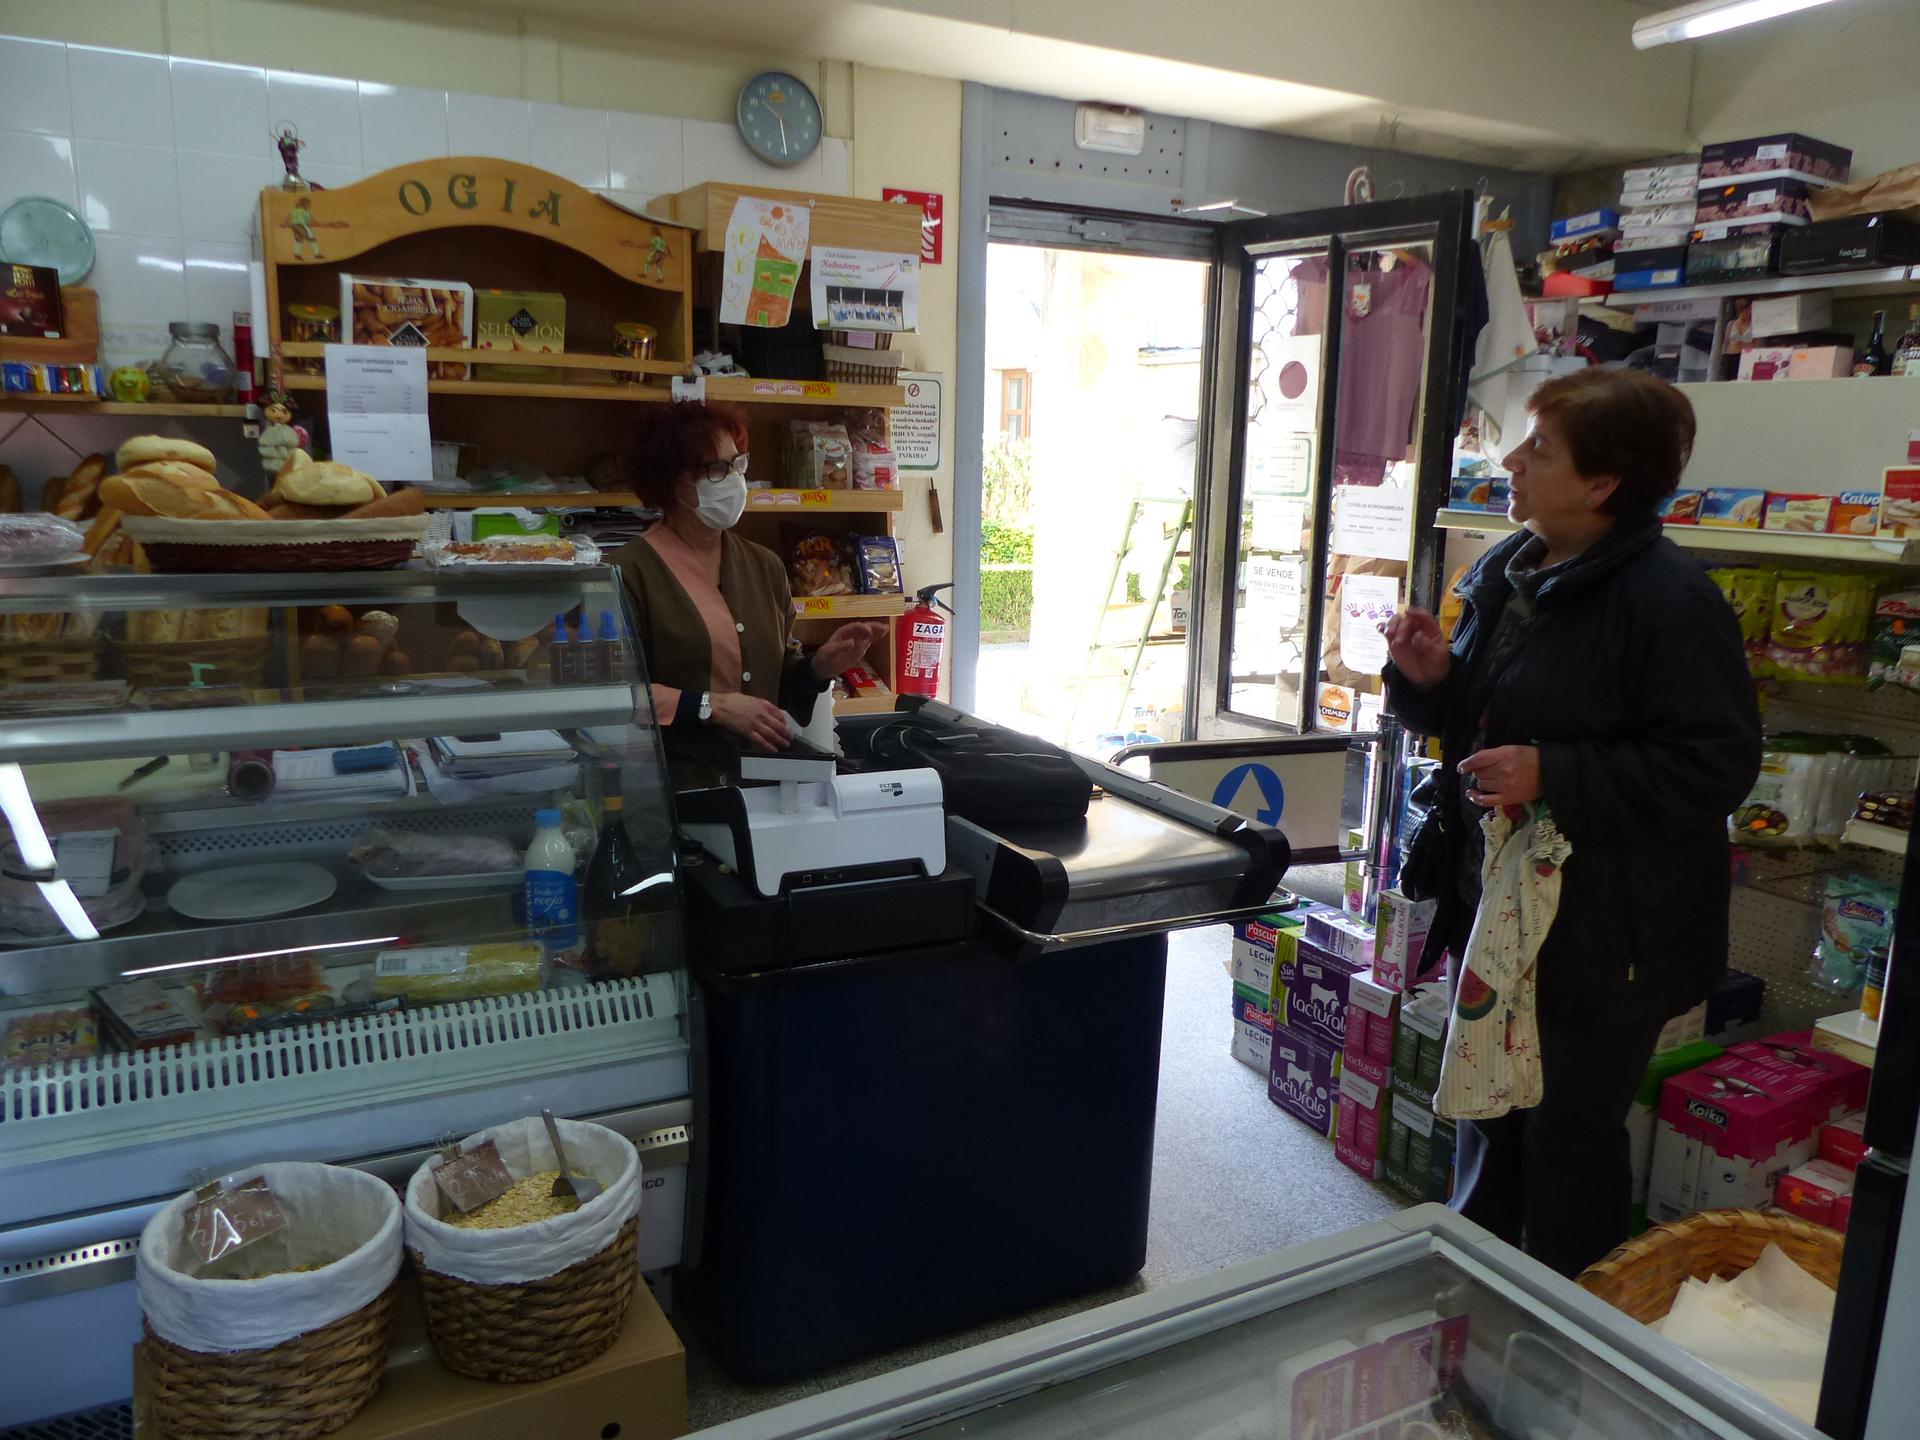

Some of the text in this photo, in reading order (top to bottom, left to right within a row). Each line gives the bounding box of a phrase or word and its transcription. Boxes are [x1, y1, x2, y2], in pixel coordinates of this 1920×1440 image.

[398, 173, 564, 227] OGIA
[478, 319, 566, 338] SELEIÓN
[1840, 493, 1881, 506] Calvo
[1253, 566, 1294, 580] SE VENDE
[904, 640, 914, 677] POLVO
[1321, 707, 1347, 719] CHIMBO
[1247, 923, 1277, 942] Pascua
[1245, 1006, 1272, 1024] Pascual
[1244, 1028, 1271, 1046] LECHE
[1271, 1070, 1326, 1115] lacturale
[1688, 1100, 1725, 1124] Kaiku
